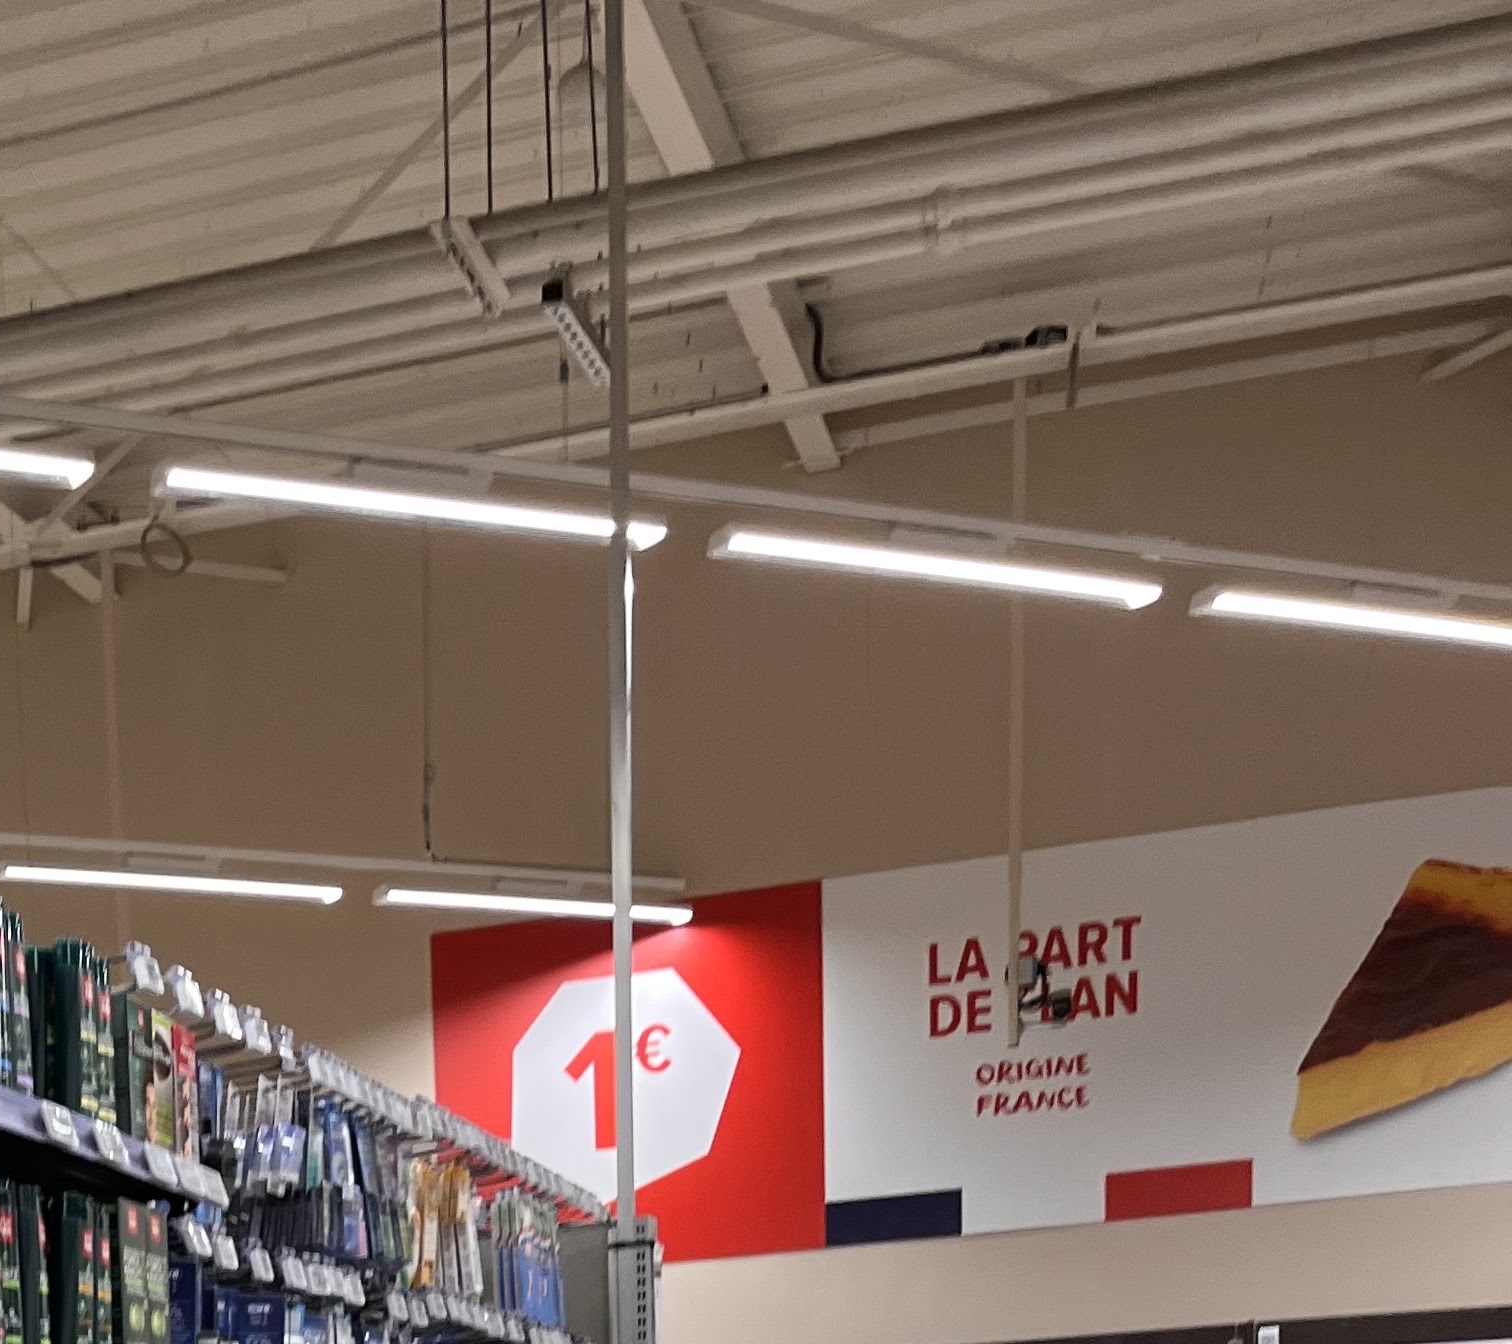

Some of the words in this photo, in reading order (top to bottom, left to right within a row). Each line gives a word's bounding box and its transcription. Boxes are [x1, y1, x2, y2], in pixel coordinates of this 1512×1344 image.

[926, 936, 991, 988] LA
[928, 988, 993, 1040] DE
[1018, 968, 1140, 1024] LAN
[974, 1052, 1092, 1086] ORIGINE
[974, 1085, 1091, 1118] FRANCE
